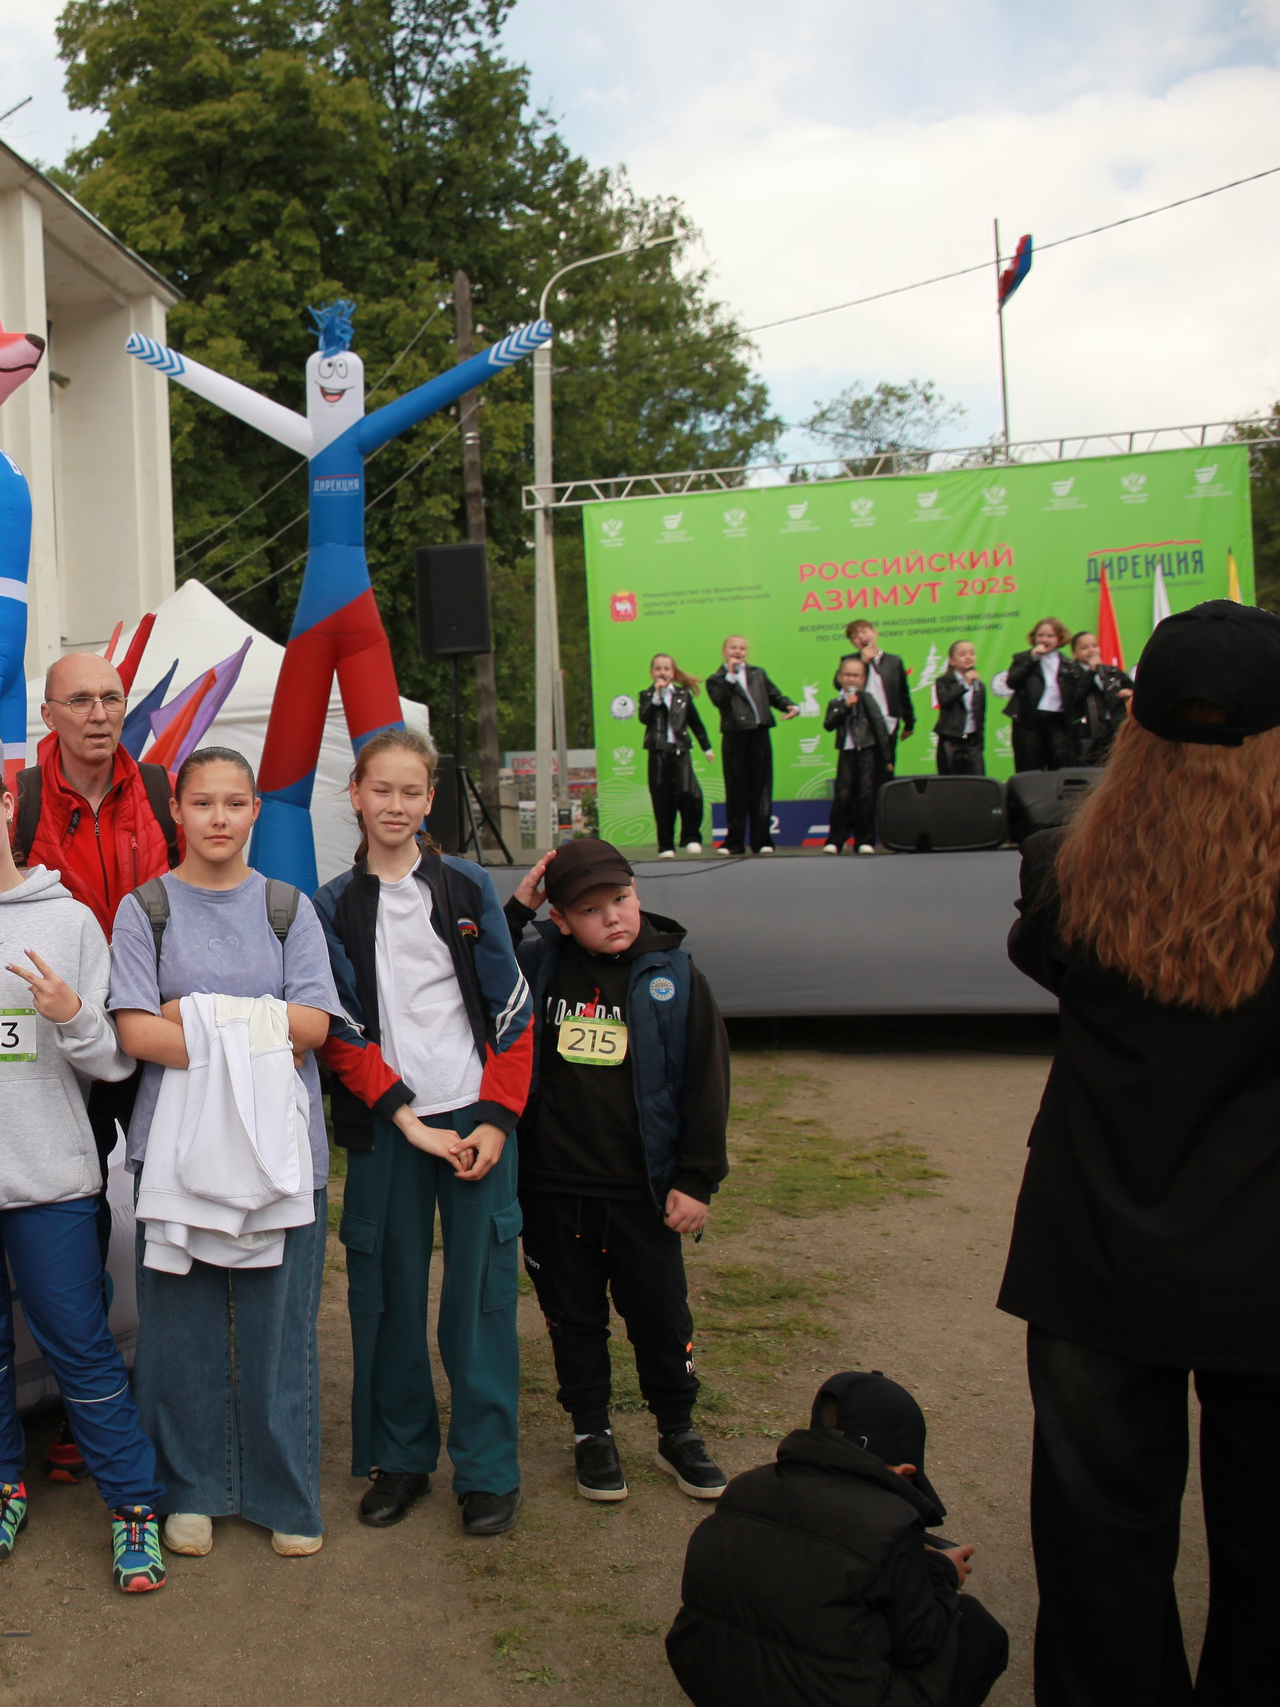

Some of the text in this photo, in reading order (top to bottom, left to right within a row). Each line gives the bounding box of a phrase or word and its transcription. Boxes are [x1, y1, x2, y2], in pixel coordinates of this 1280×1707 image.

[313, 479, 360, 492] ДИРЕКЦИЯ
[799, 543, 1014, 583] РОССИЙСКИЙ
[801, 576, 1018, 613] АЗИМУТ 2025
[567, 1027, 618, 1055] 215
